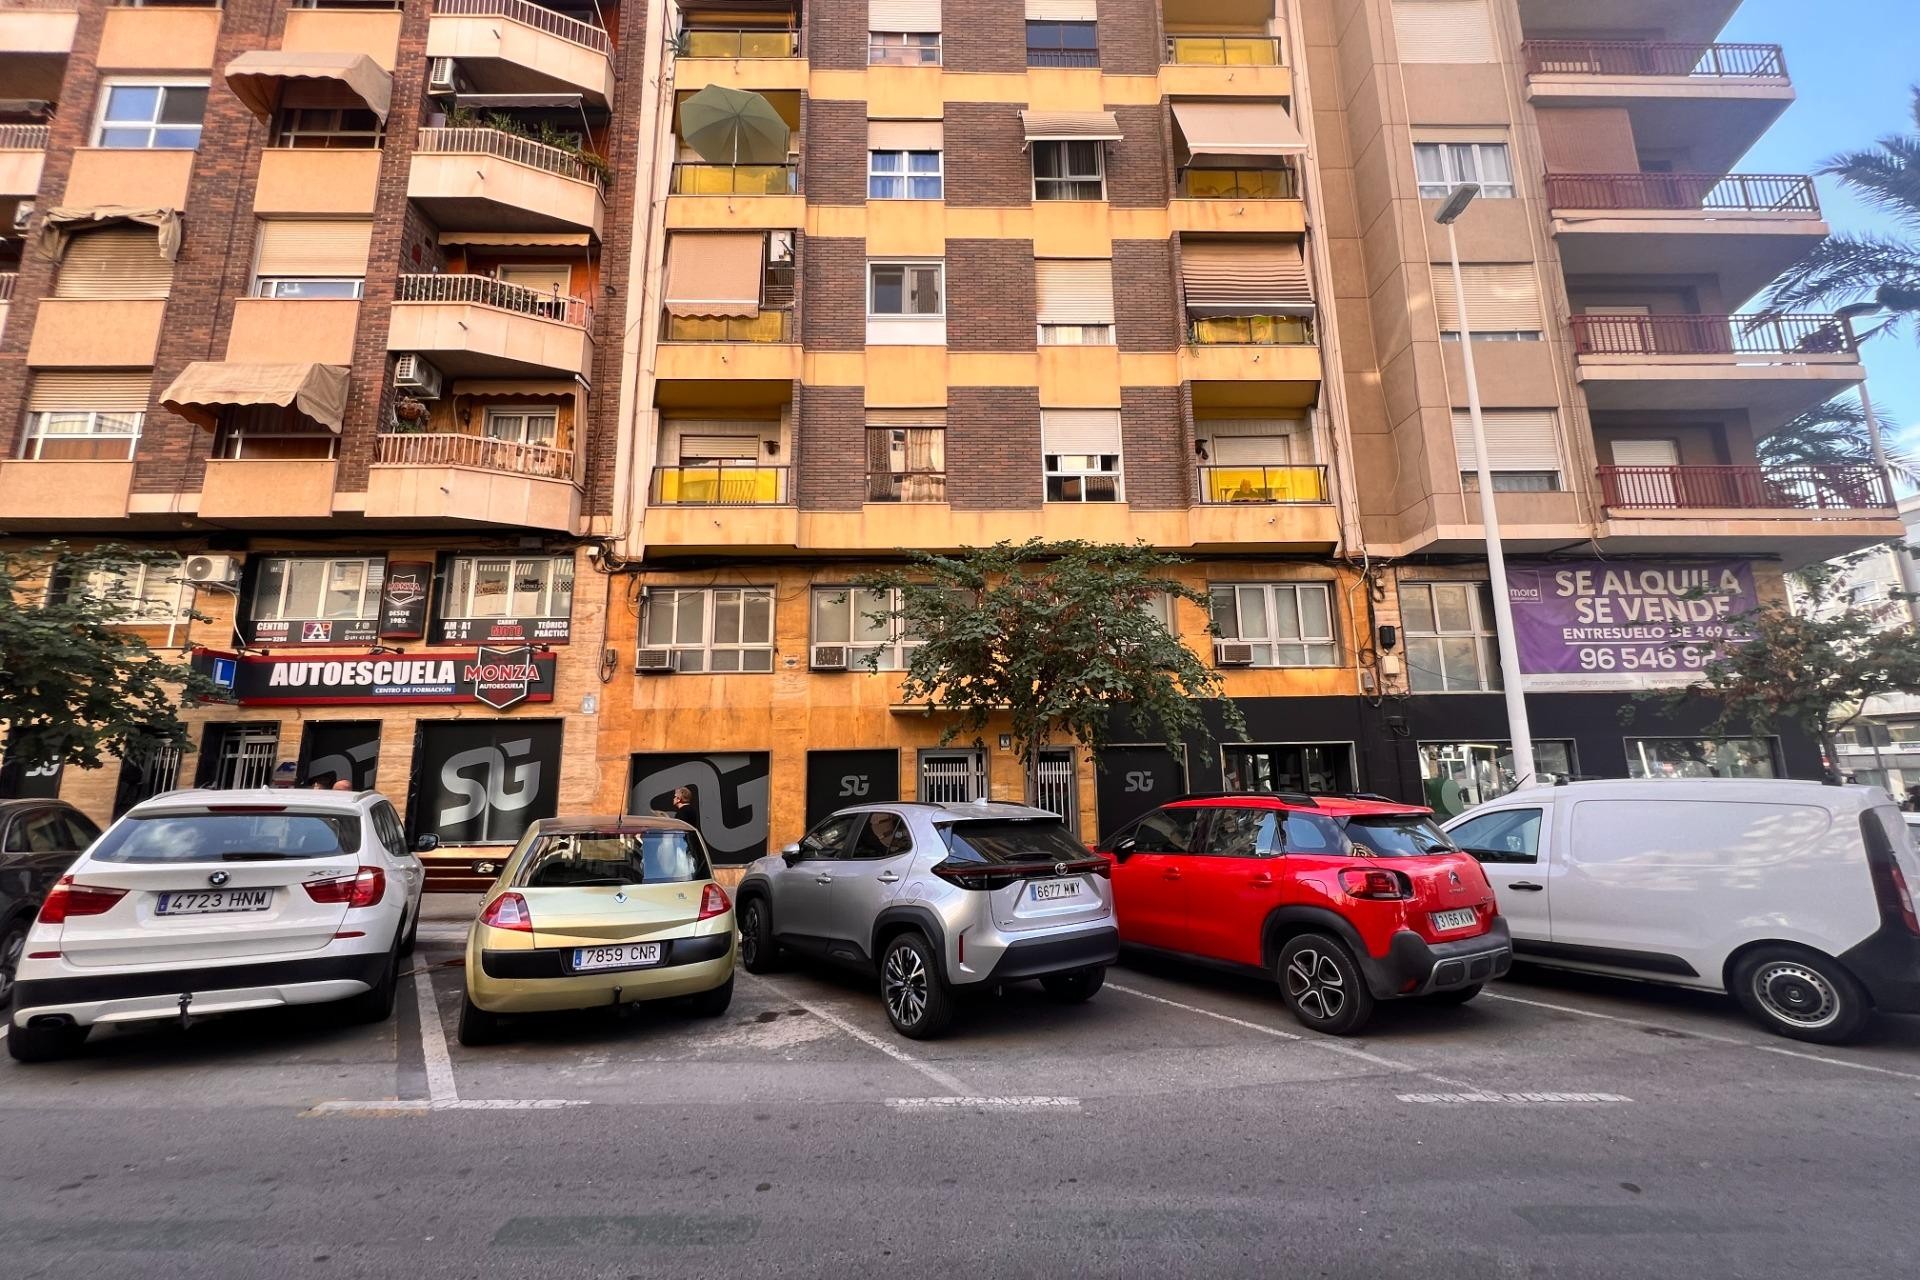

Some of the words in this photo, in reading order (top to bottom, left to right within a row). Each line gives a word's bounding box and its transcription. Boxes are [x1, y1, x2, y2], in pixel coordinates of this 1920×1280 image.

[1555, 570, 1595, 596] SE
[1602, 569, 1742, 596] ALQUILA
[1575, 598, 1613, 624] SE
[1618, 596, 1729, 622] VENDE
[257, 622, 289, 631] CENTRO
[1563, 627, 1666, 640] ENTRESUELO
[1580, 648, 1615, 670] 96
[1621, 647, 1677, 669] 546
[215, 662, 230, 685] L
[269, 661, 456, 686] AUTOESCUELA
[464, 664, 540, 682] MONZA
[479, 682, 524, 690] AUTOESCUELA
[440, 738, 542, 828] SG
[838, 774, 870, 797] SG
[1125, 770, 1154, 792] SG
[171, 894, 222, 910] 4723
[228, 892, 266, 907] HNM
[1037, 884, 1060, 898] 6677
[1439, 913, 1460, 928] 3166
[587, 948, 623, 964] 7859
[630, 945, 656, 960] CNR
